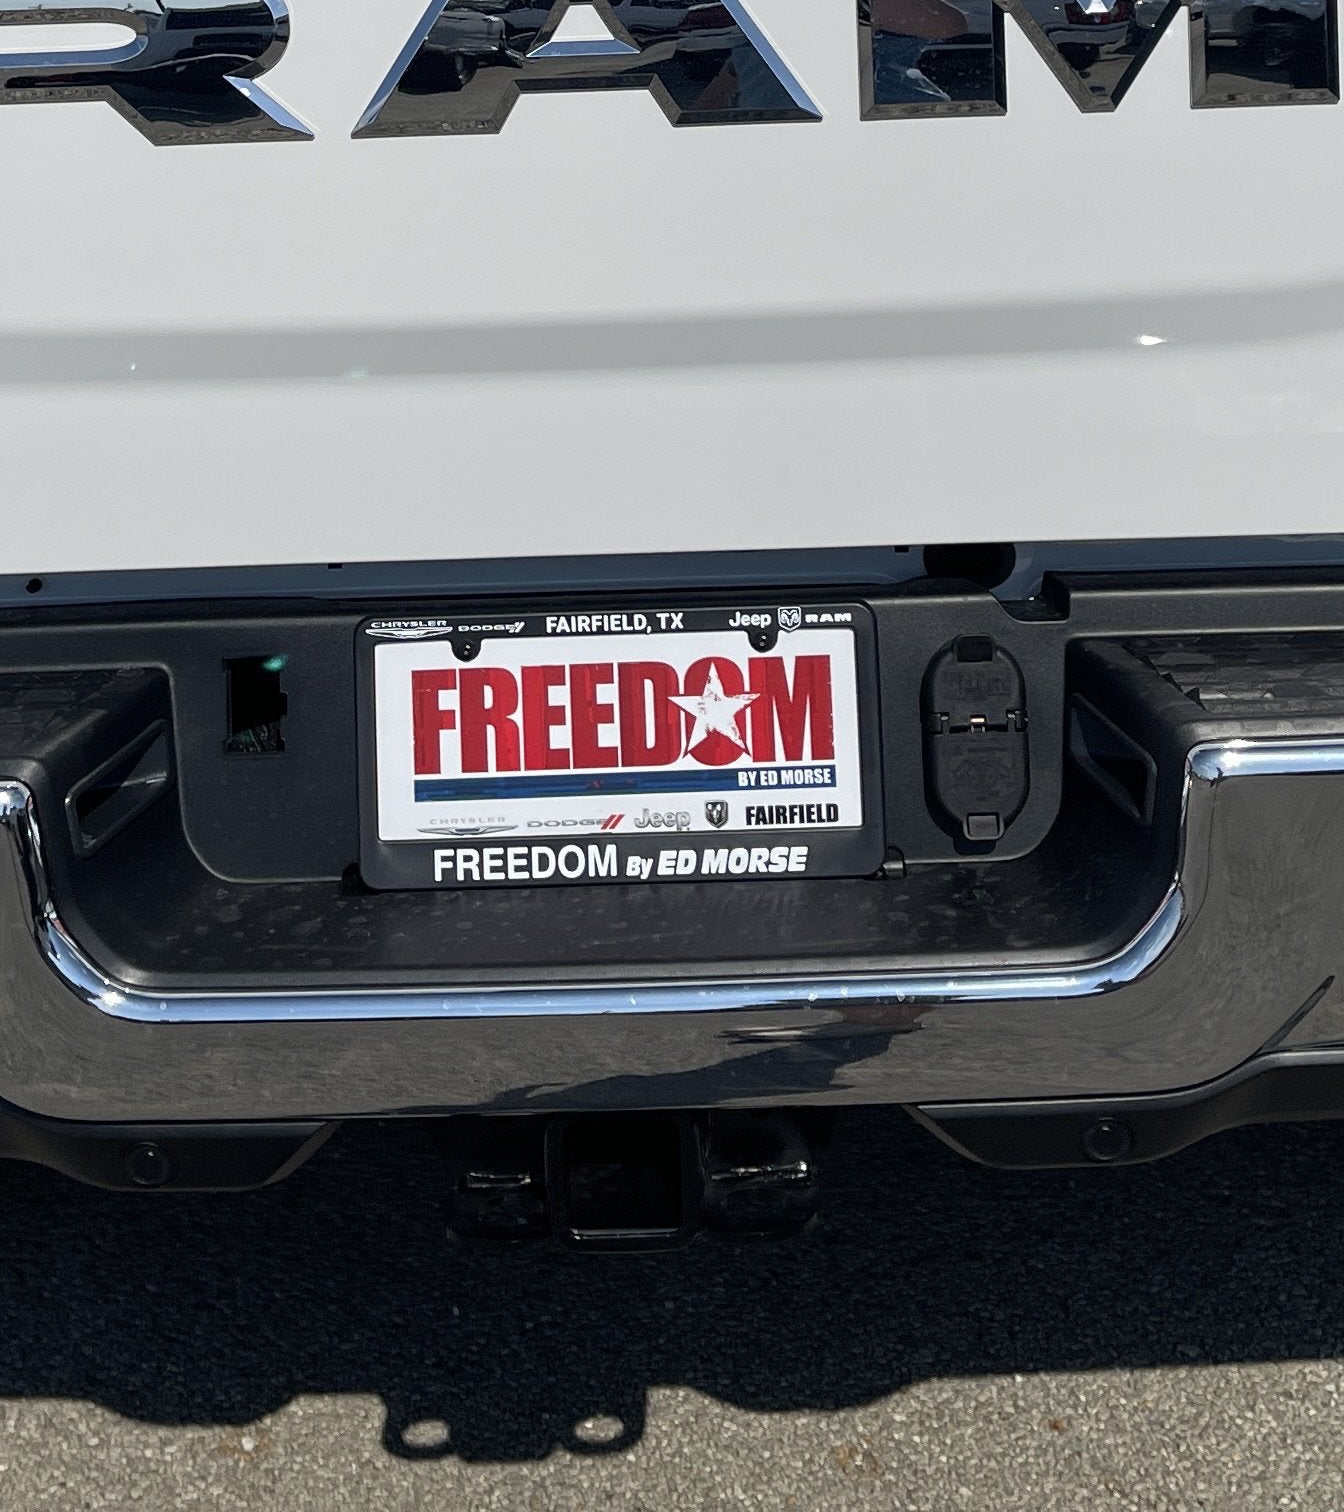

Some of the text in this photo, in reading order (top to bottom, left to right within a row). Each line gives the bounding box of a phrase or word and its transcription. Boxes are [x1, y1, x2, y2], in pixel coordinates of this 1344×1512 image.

[370, 620, 447, 628] CHRYSLER
[545, 612, 685, 635] FAIRFIELD, TX
[728, 611, 772, 628] Jeep
[805, 612, 852, 623] RAM
[458, 624, 516, 632] DODGE
[411, 654, 836, 775] FREEDOM
[737, 768, 833, 787] BY ED MORSE
[429, 816, 506, 825] CHRYSLER
[527, 818, 609, 828] DODGE
[633, 808, 692, 831] Jeep
[745, 803, 839, 826] FAIRFIELD
[433, 844, 809, 882] FREEDOM By ED MORSE
